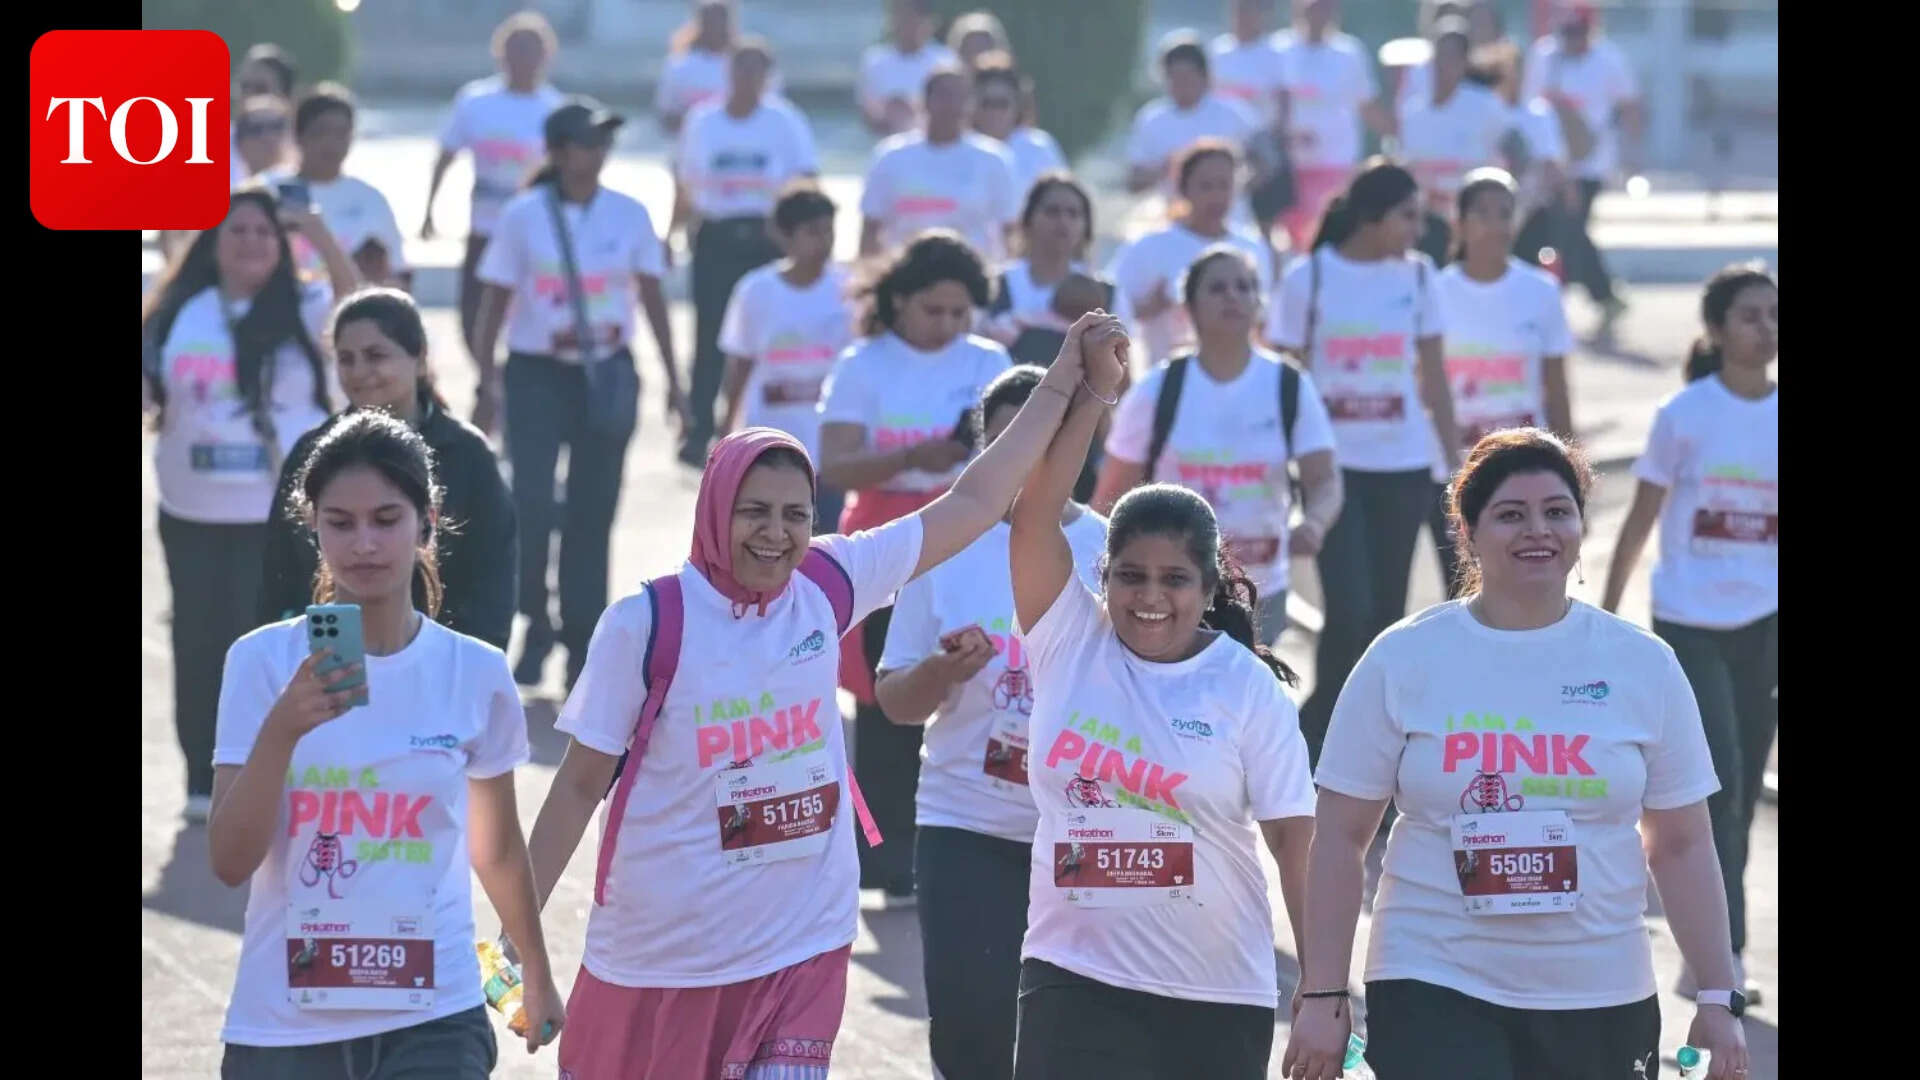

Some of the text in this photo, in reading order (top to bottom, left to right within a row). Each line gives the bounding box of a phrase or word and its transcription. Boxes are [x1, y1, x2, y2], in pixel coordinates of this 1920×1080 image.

[697, 697, 823, 768] PINK
[1080, 717, 1121, 745] AM
[1125, 735, 1142, 754] A
[1045, 728, 1188, 811] PINK
[1443, 732, 1596, 776] PINK
[288, 790, 434, 838] PINK
[763, 793, 823, 825] 51755
[1068, 829, 1113, 838] Pinkathon
[1097, 848, 1164, 869] 51743
[1490, 852, 1554, 875] 55051
[331, 944, 406, 968] 51269
